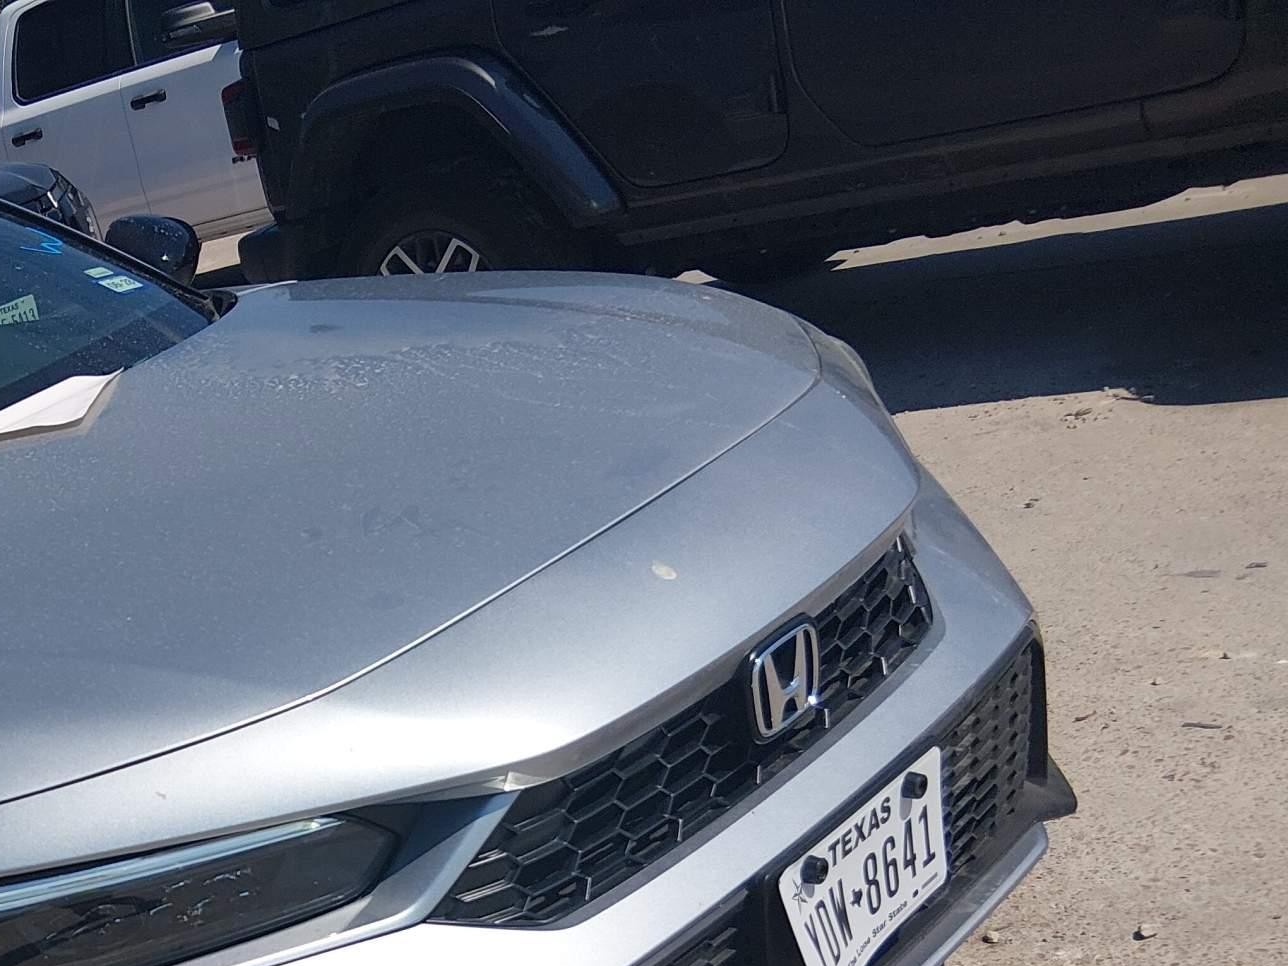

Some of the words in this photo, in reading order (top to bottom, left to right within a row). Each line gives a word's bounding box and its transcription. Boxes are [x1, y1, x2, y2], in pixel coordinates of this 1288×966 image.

[827, 796, 892, 868] TEXAS
[863, 804, 936, 916] 8641
[871, 919, 887, 938] Star
